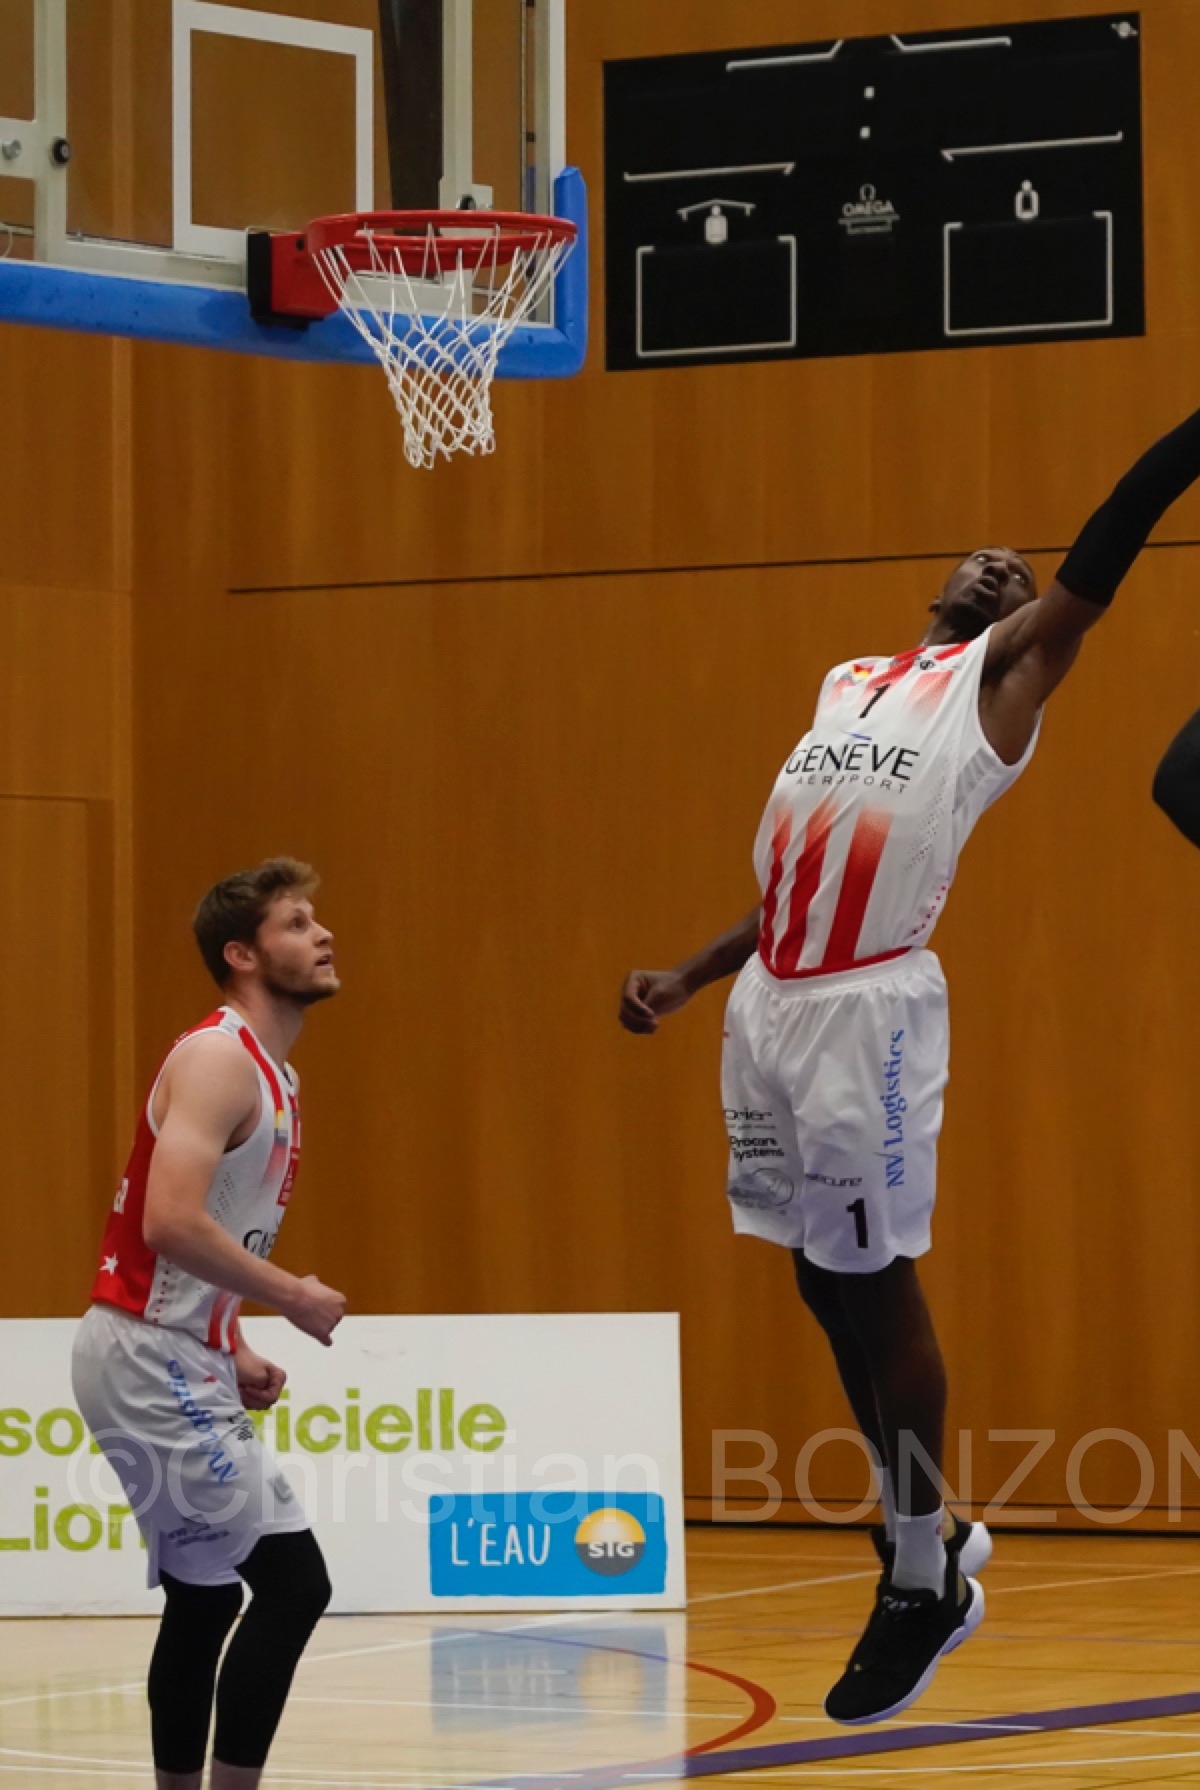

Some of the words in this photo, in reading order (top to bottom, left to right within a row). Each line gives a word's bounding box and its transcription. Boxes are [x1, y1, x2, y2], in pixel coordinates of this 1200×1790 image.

[842, 200, 895, 217] OMEGA
[859, 683, 890, 718] 1
[846, 1198, 869, 1249] 1
[0, 1407, 103, 1457] so
[451, 1517, 550, 1567] L'EAU
[588, 1540, 635, 1559] SIG
